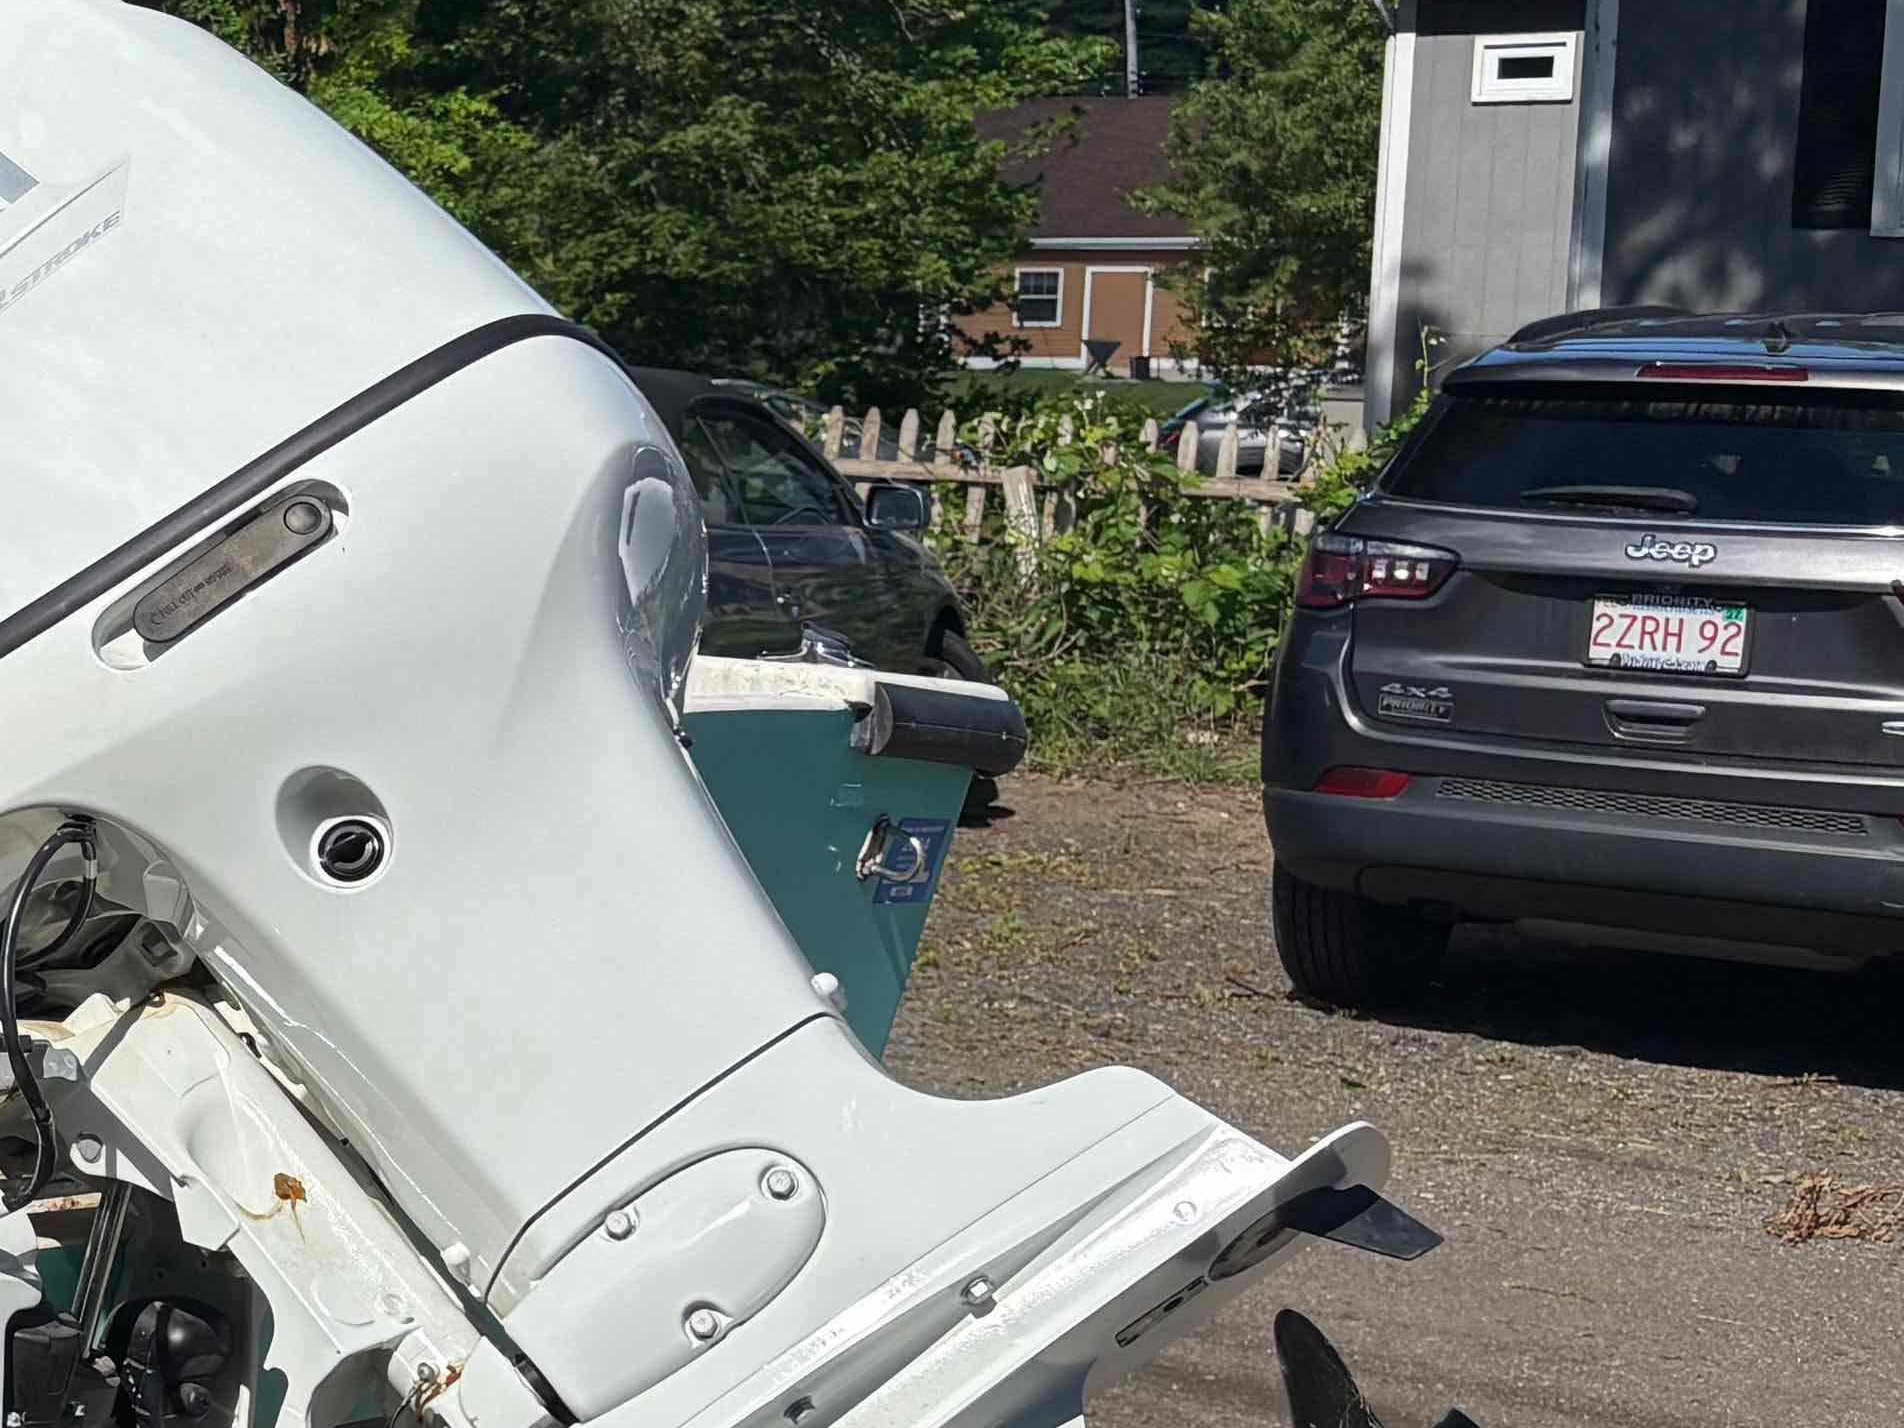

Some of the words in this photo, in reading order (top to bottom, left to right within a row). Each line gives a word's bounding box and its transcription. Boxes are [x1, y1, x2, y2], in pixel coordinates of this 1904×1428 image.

[1625, 534, 1717, 568] Jeep
[1632, 594, 1713, 608] PRIORITY
[1592, 613, 1684, 653] 2ZRH
[1697, 619, 1742, 657] 92
